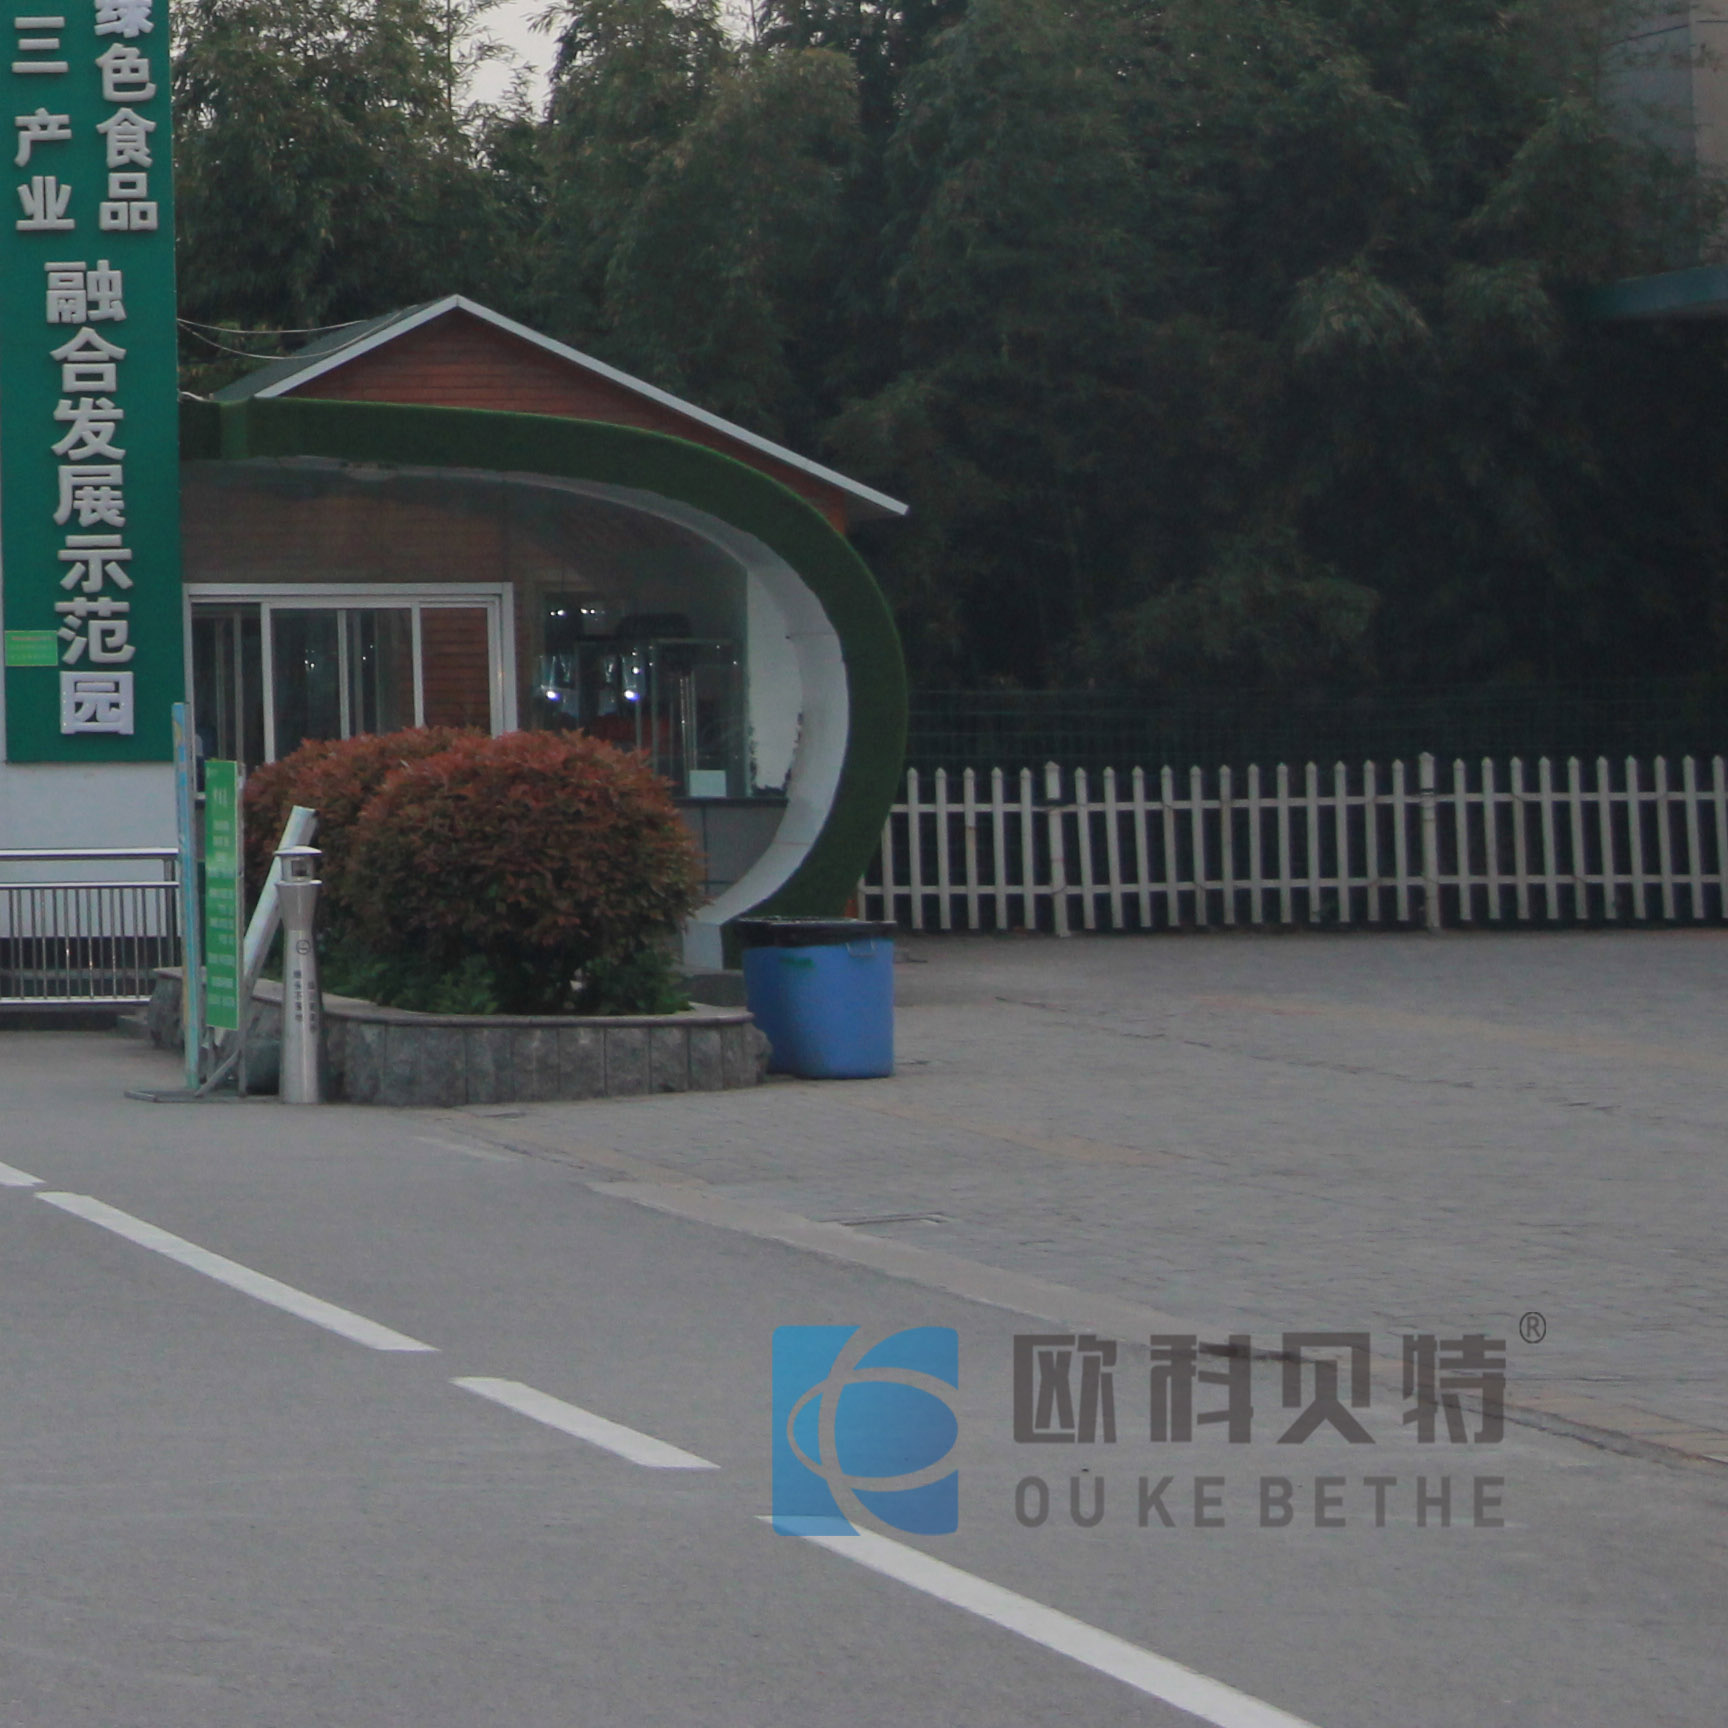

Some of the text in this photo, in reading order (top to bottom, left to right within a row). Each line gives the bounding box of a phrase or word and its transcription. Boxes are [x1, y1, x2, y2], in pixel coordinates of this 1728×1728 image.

[45, 259, 134, 735] 融合发展示范园
